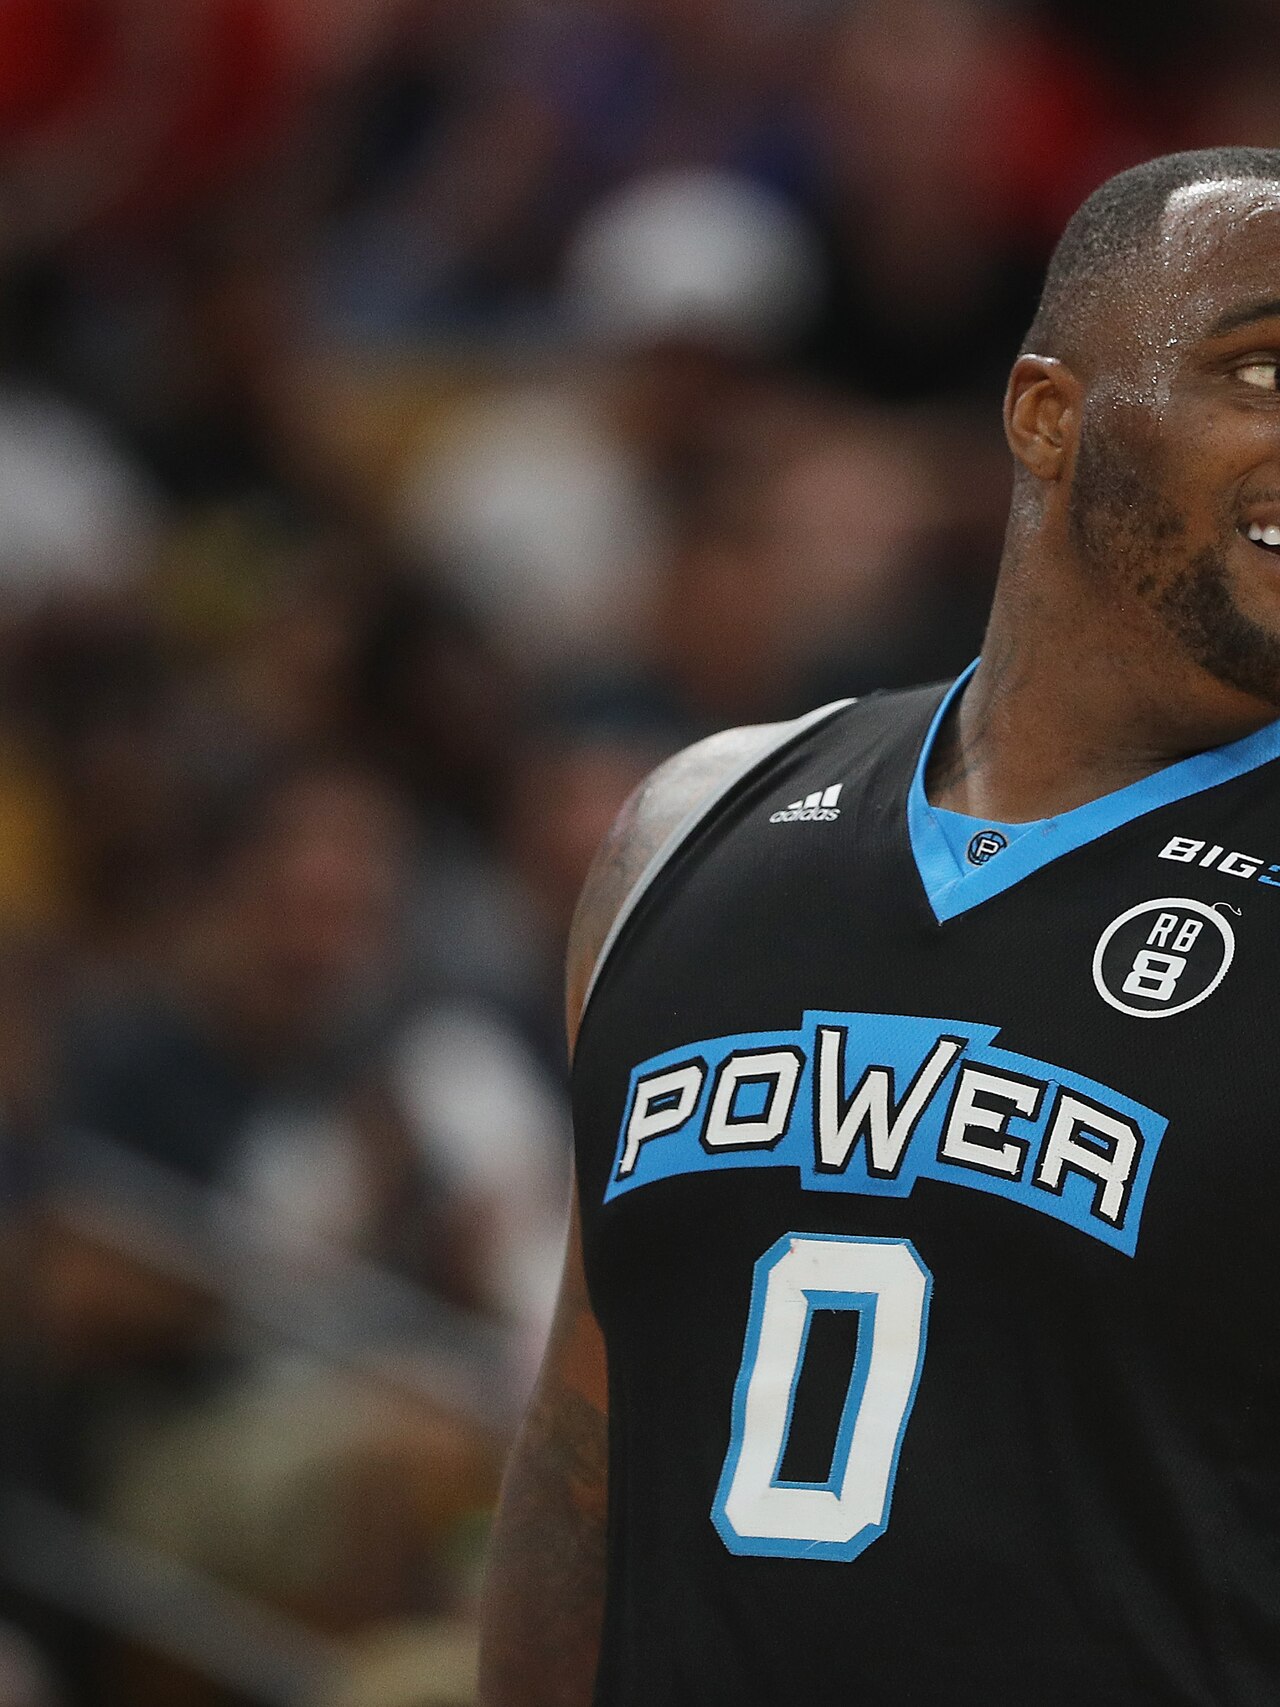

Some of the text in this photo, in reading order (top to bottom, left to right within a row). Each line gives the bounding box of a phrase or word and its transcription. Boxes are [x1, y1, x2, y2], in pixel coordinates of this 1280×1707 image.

[769, 805, 842, 824] adidas
[974, 837, 1001, 858] P
[1146, 912, 1204, 953] RB
[1121, 949, 1187, 1001] 8
[616, 1024, 1146, 1229] POWER
[709, 1231, 933, 1562] 0
